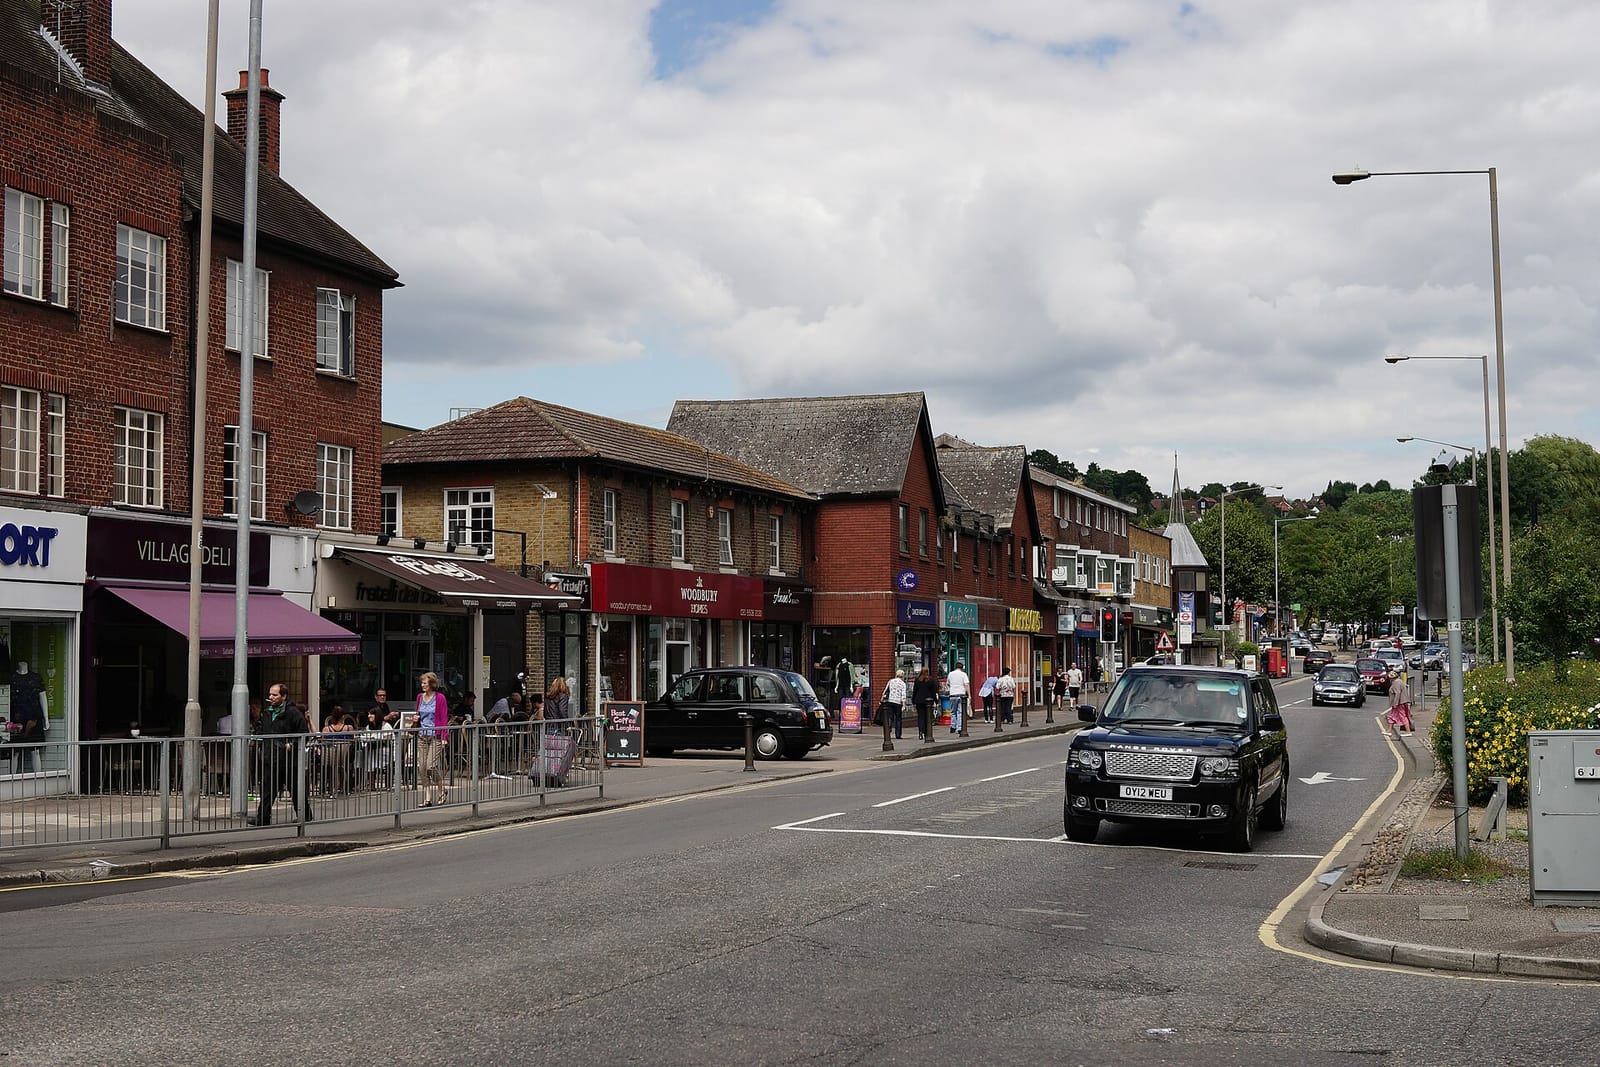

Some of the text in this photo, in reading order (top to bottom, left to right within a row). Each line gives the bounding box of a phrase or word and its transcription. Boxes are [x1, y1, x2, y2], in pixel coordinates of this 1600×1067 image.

[137, 539, 193, 565] VILLAG
[201, 545, 231, 567] DELI
[680, 587, 718, 602] WOODBURY
[690, 603, 708, 614] HOMES
[1125, 786, 1146, 798] OY12
